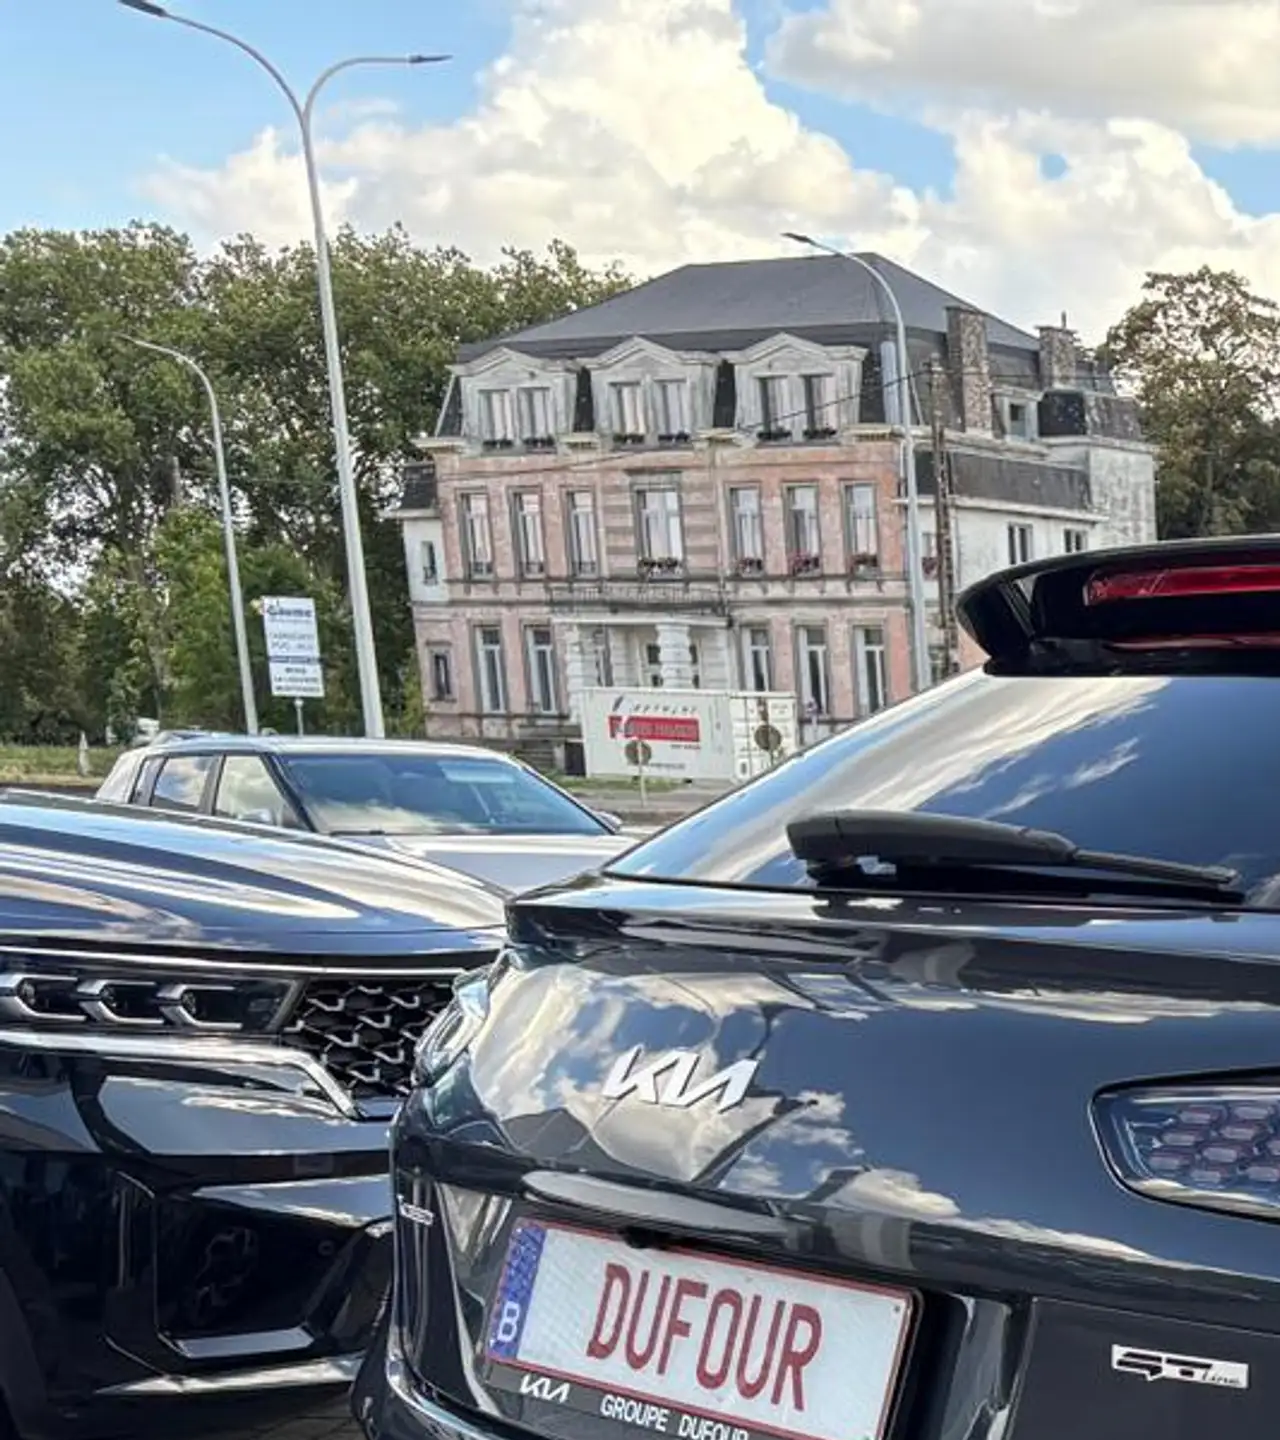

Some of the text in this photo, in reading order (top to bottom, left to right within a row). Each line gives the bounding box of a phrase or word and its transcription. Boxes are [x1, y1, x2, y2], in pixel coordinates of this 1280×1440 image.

[601, 1043, 759, 1114] KIA
[497, 1300, 520, 1342] B
[585, 1262, 823, 1412] DUFOUR
[519, 1373, 571, 1404] KIA
[600, 1394, 668, 1433] GROUPE
